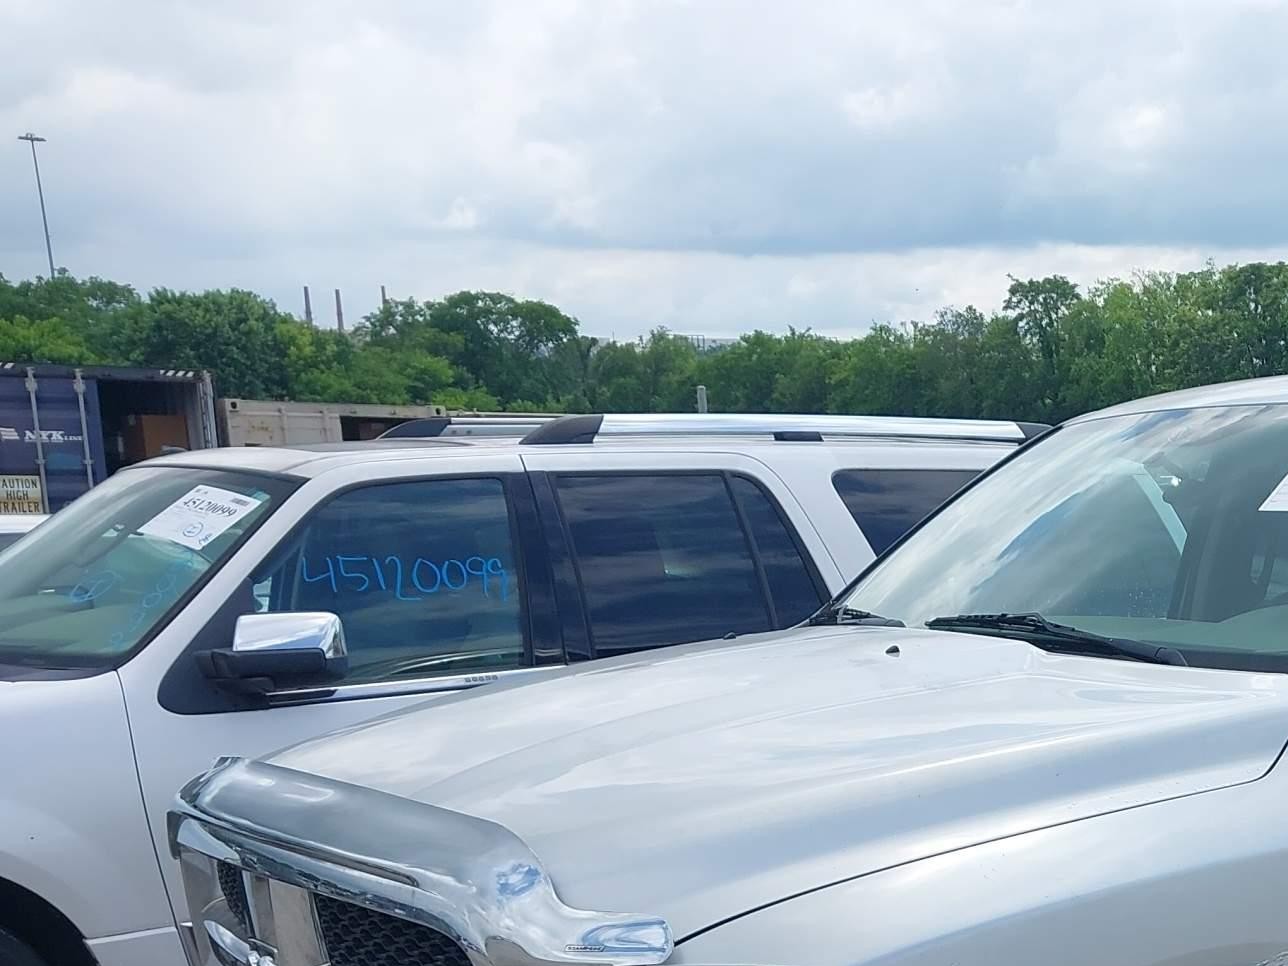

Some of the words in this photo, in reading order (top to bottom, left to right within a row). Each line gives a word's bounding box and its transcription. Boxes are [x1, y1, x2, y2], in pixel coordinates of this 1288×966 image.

[24, 430, 65, 442] NYK
[0, 478, 38, 489] AUTION
[6, 489, 29, 501] HIGH
[302, 556, 509, 600] 45120099
